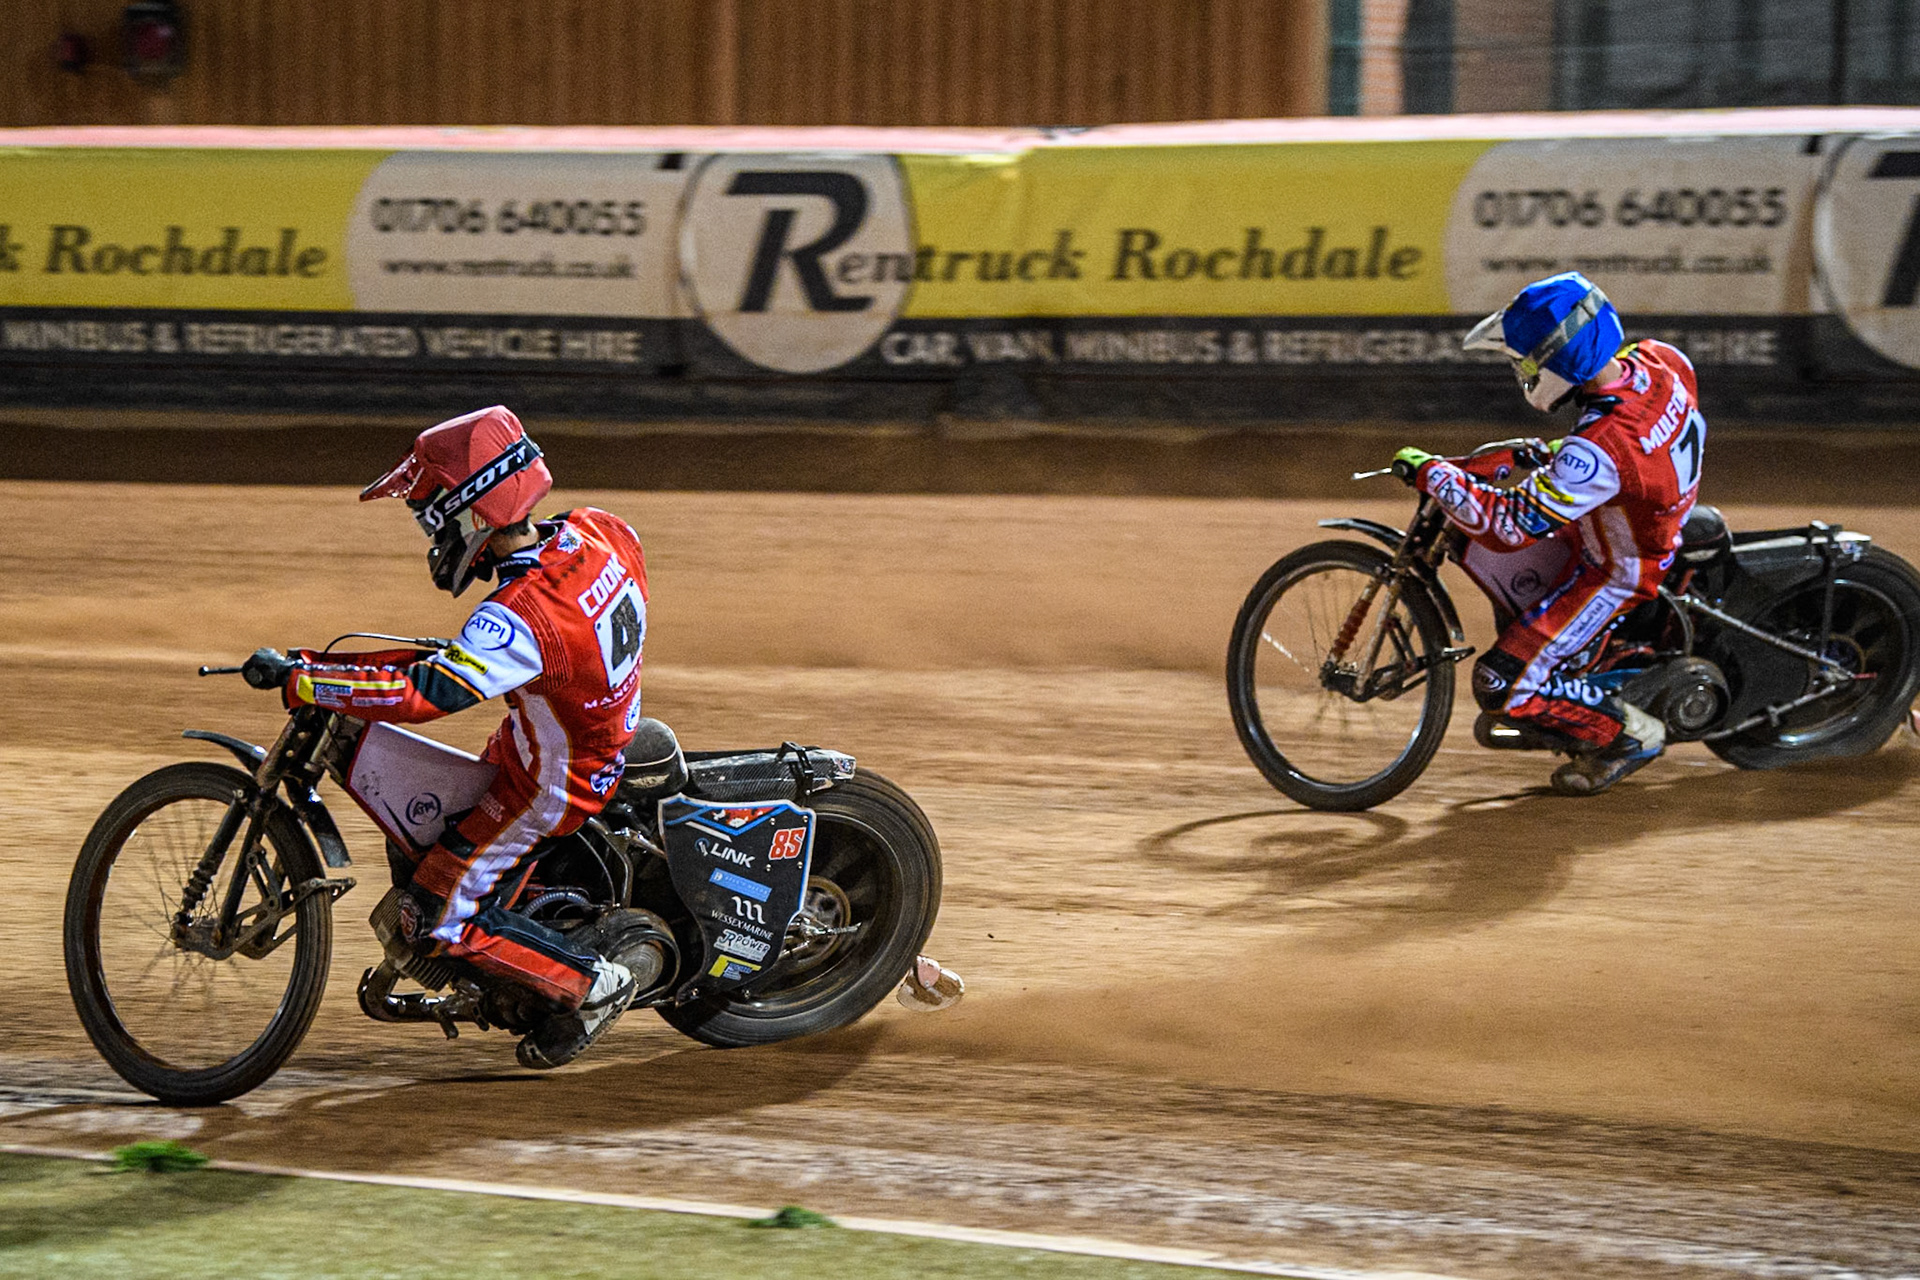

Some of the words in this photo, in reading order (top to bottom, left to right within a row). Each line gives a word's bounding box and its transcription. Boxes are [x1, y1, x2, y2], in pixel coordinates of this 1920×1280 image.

[371, 197, 488, 236] 01706
[500, 197, 646, 237] 640055
[1473, 188, 1606, 229] 01706
[1615, 187, 1788, 229] 640055
[45, 223, 328, 278] Rochdale
[1107, 226, 1421, 283] Rochdale
[4, 320, 148, 353] MINIBUS
[186, 322, 419, 358] REFRIGERATED
[424, 326, 556, 361] VEHICLE
[562, 330, 642, 364] HIRE
[444, 445, 527, 515] SCOTT
[1558, 451, 1592, 474] ATPI
[577, 552, 627, 618] COOK
[468, 617, 506, 640] ATPI
[610, 592, 642, 671] 4
[711, 842, 756, 869] LINK
[769, 826, 806, 861] 85
